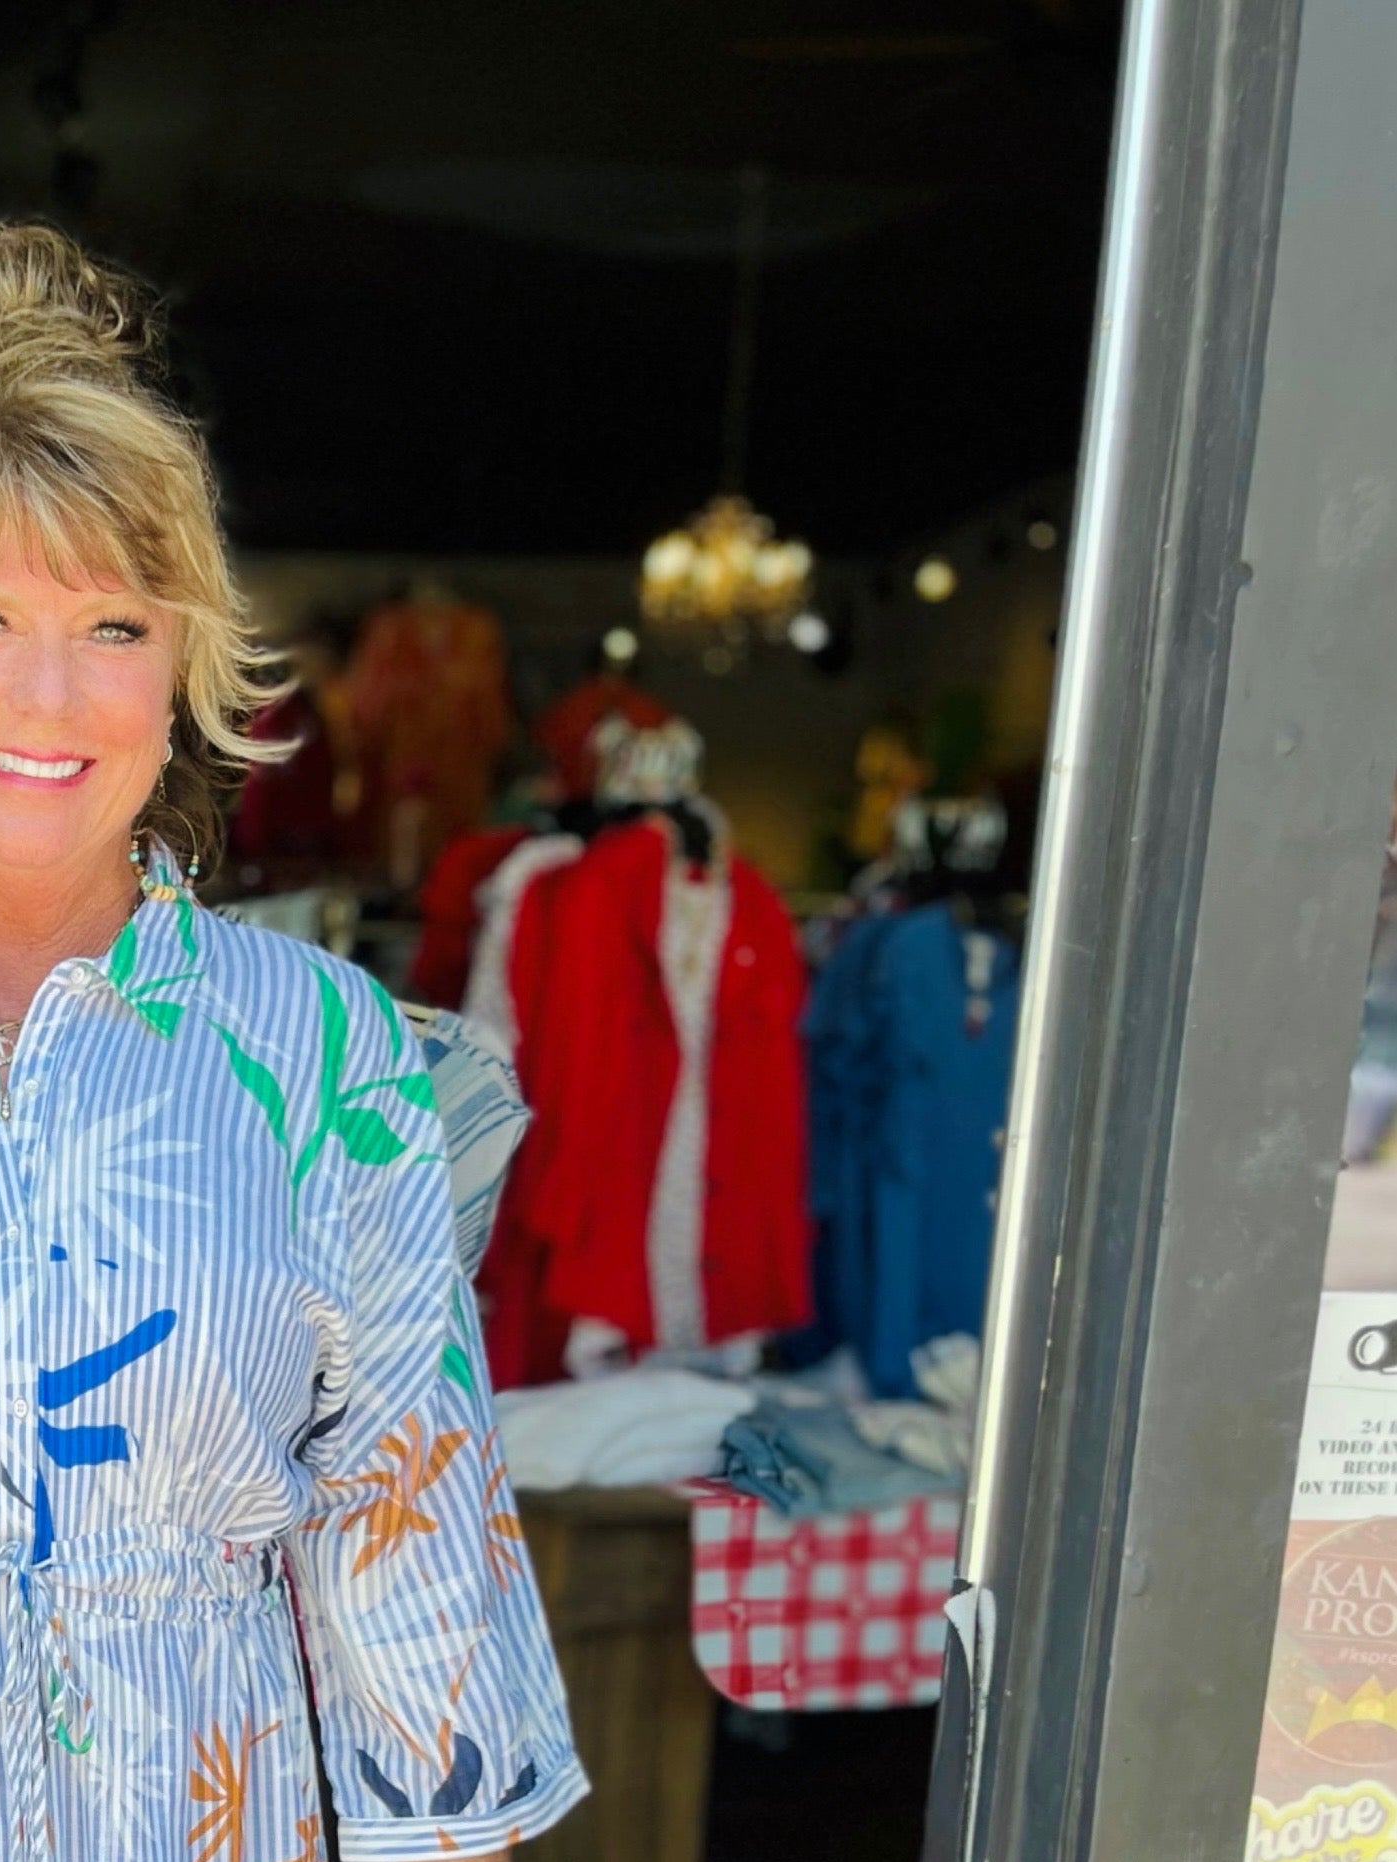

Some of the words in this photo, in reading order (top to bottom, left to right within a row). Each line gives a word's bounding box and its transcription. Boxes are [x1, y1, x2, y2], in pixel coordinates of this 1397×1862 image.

[1360, 1420, 1382, 1434] 24
[1318, 1440, 1373, 1455] VIDEO
[1299, 1481, 1323, 1495] ON
[1330, 1480, 1388, 1495] THESE
[1303, 1598, 1397, 1637] PRO
